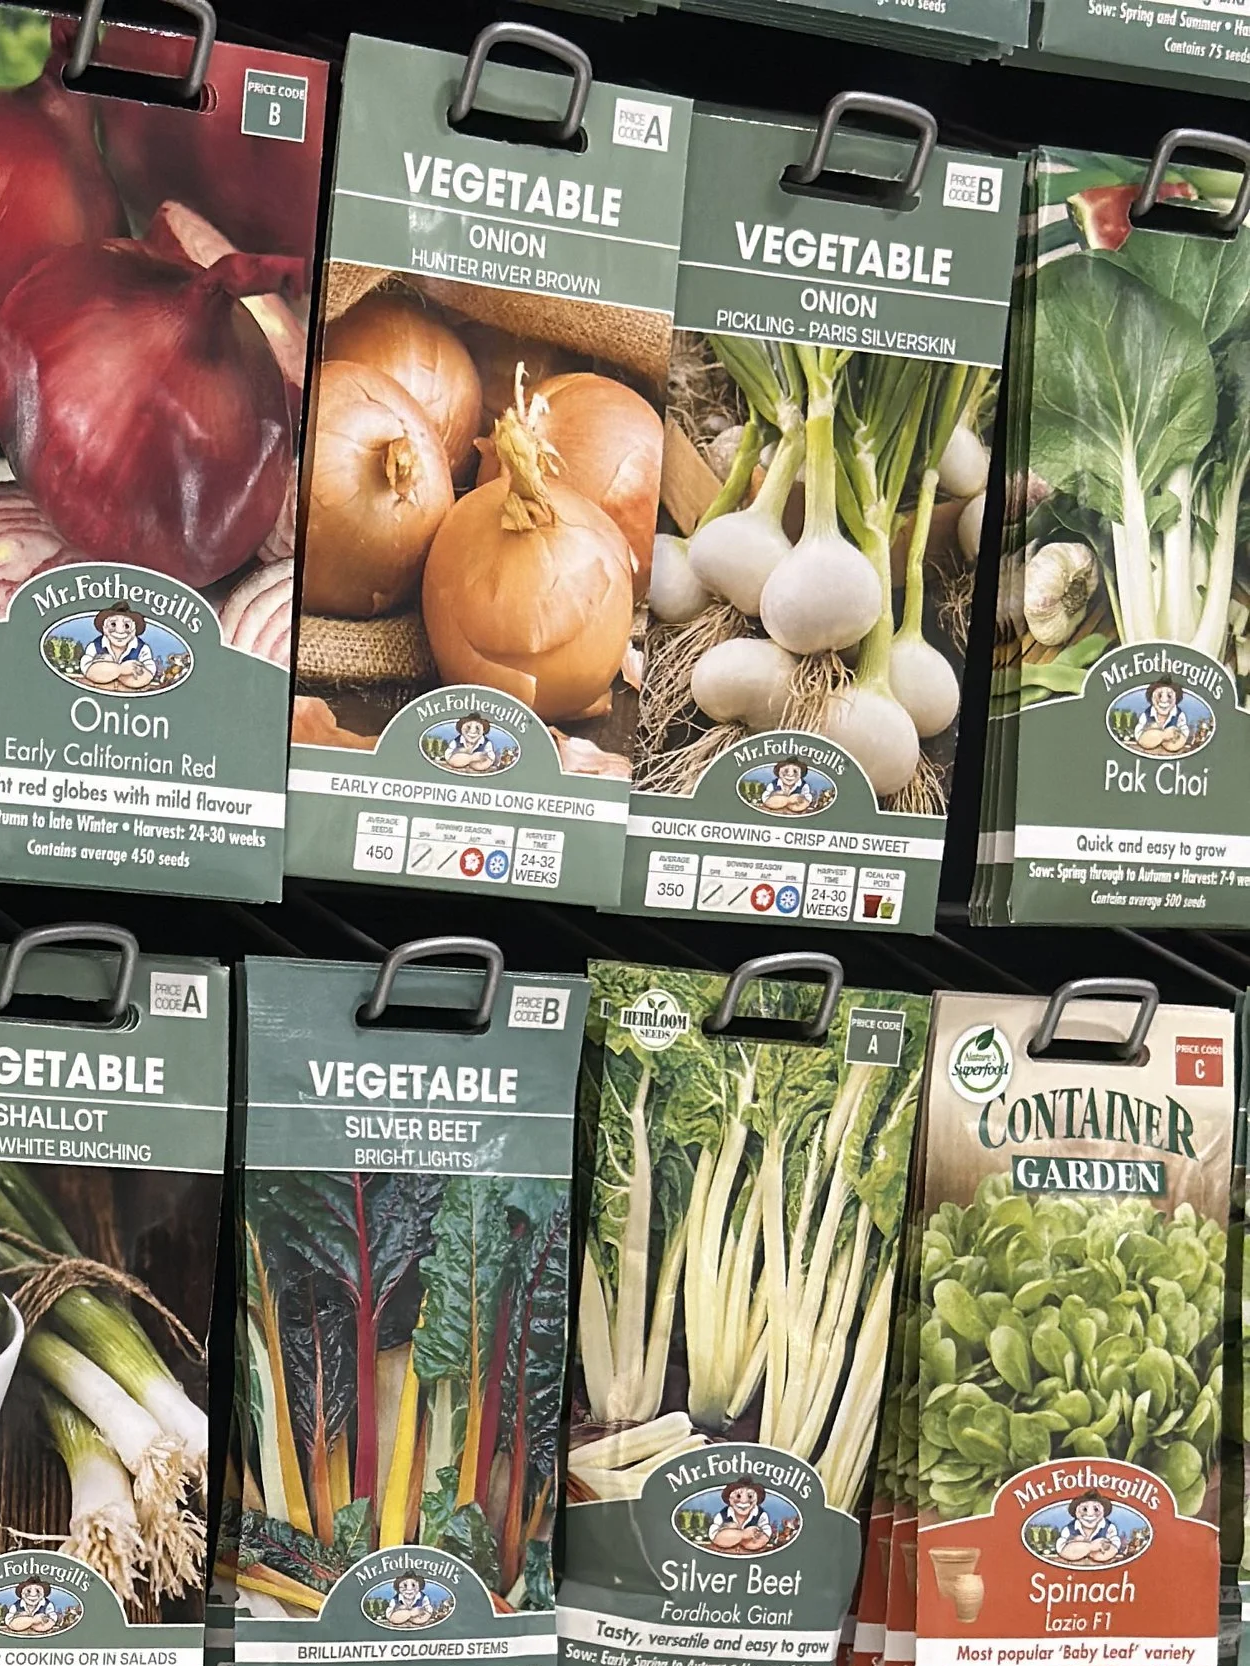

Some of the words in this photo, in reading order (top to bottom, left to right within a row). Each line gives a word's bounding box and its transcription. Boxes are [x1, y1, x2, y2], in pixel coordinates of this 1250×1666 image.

[1088, 0, 1116, 17] Sow:
[1120, 2, 1153, 27] Spring
[1157, 10, 1176, 26] and
[1180, 11, 1222, 33] Summer
[644, 116, 663, 146] A
[403, 152, 622, 227] VEGETABLE
[978, 177, 993, 205] B
[469, 225, 546, 258] ONION
[735, 221, 952, 286] VEGETABLE
[411, 248, 478, 277] HUNTER
[482, 260, 531, 286] RIVER
[535, 269, 601, 296] BROWN
[801, 288, 877, 318] ONION
[717, 309, 795, 336] PICKLING
[810, 322, 856, 344] PARIS
[861, 328, 956, 355] SILVERSKIN
[70, 696, 169, 739] Onion
[5, 737, 56, 769] Early
[64, 743, 172, 775] Californian
[182, 755, 216, 779] Red
[1105, 760, 1146, 793] Pak
[1156, 763, 1208, 796] Choi
[657, 883, 684, 897] 350
[308, 1060, 519, 1104] VEGETABLE
[951, 1061, 1009, 1078] Superfood
[345, 1116, 423, 1140] SILVER
[428, 1121, 482, 1143] BEET
[978, 1087, 1198, 1160] CONTAINER
[60, 1140, 151, 1163] BUNCHING
[355, 1148, 413, 1166] BRIGHT
[419, 1151, 472, 1169] LIGHTS
[1017, 1158, 1160, 1193] GARDEN
[661, 1559, 737, 1594] Silver
[747, 1564, 802, 1596] Beet
[1029, 1571, 1135, 1612] Spinach
[661, 1601, 741, 1624] Fordhook
[748, 1605, 793, 1625] Giant
[1045, 1612, 1087, 1632] Lazio
[1093, 1612, 1112, 1631] F1
[5, 1652, 74, 1666] COOKING
[78, 1652, 99, 1666] OR
[102, 1652, 116, 1666] IN
[120, 1651, 178, 1666] SALADS
[298, 1644, 387, 1660] BRILLIANTLY
[391, 1644, 464, 1658] COLOURED
[467, 1641, 508, 1655] STEMS
